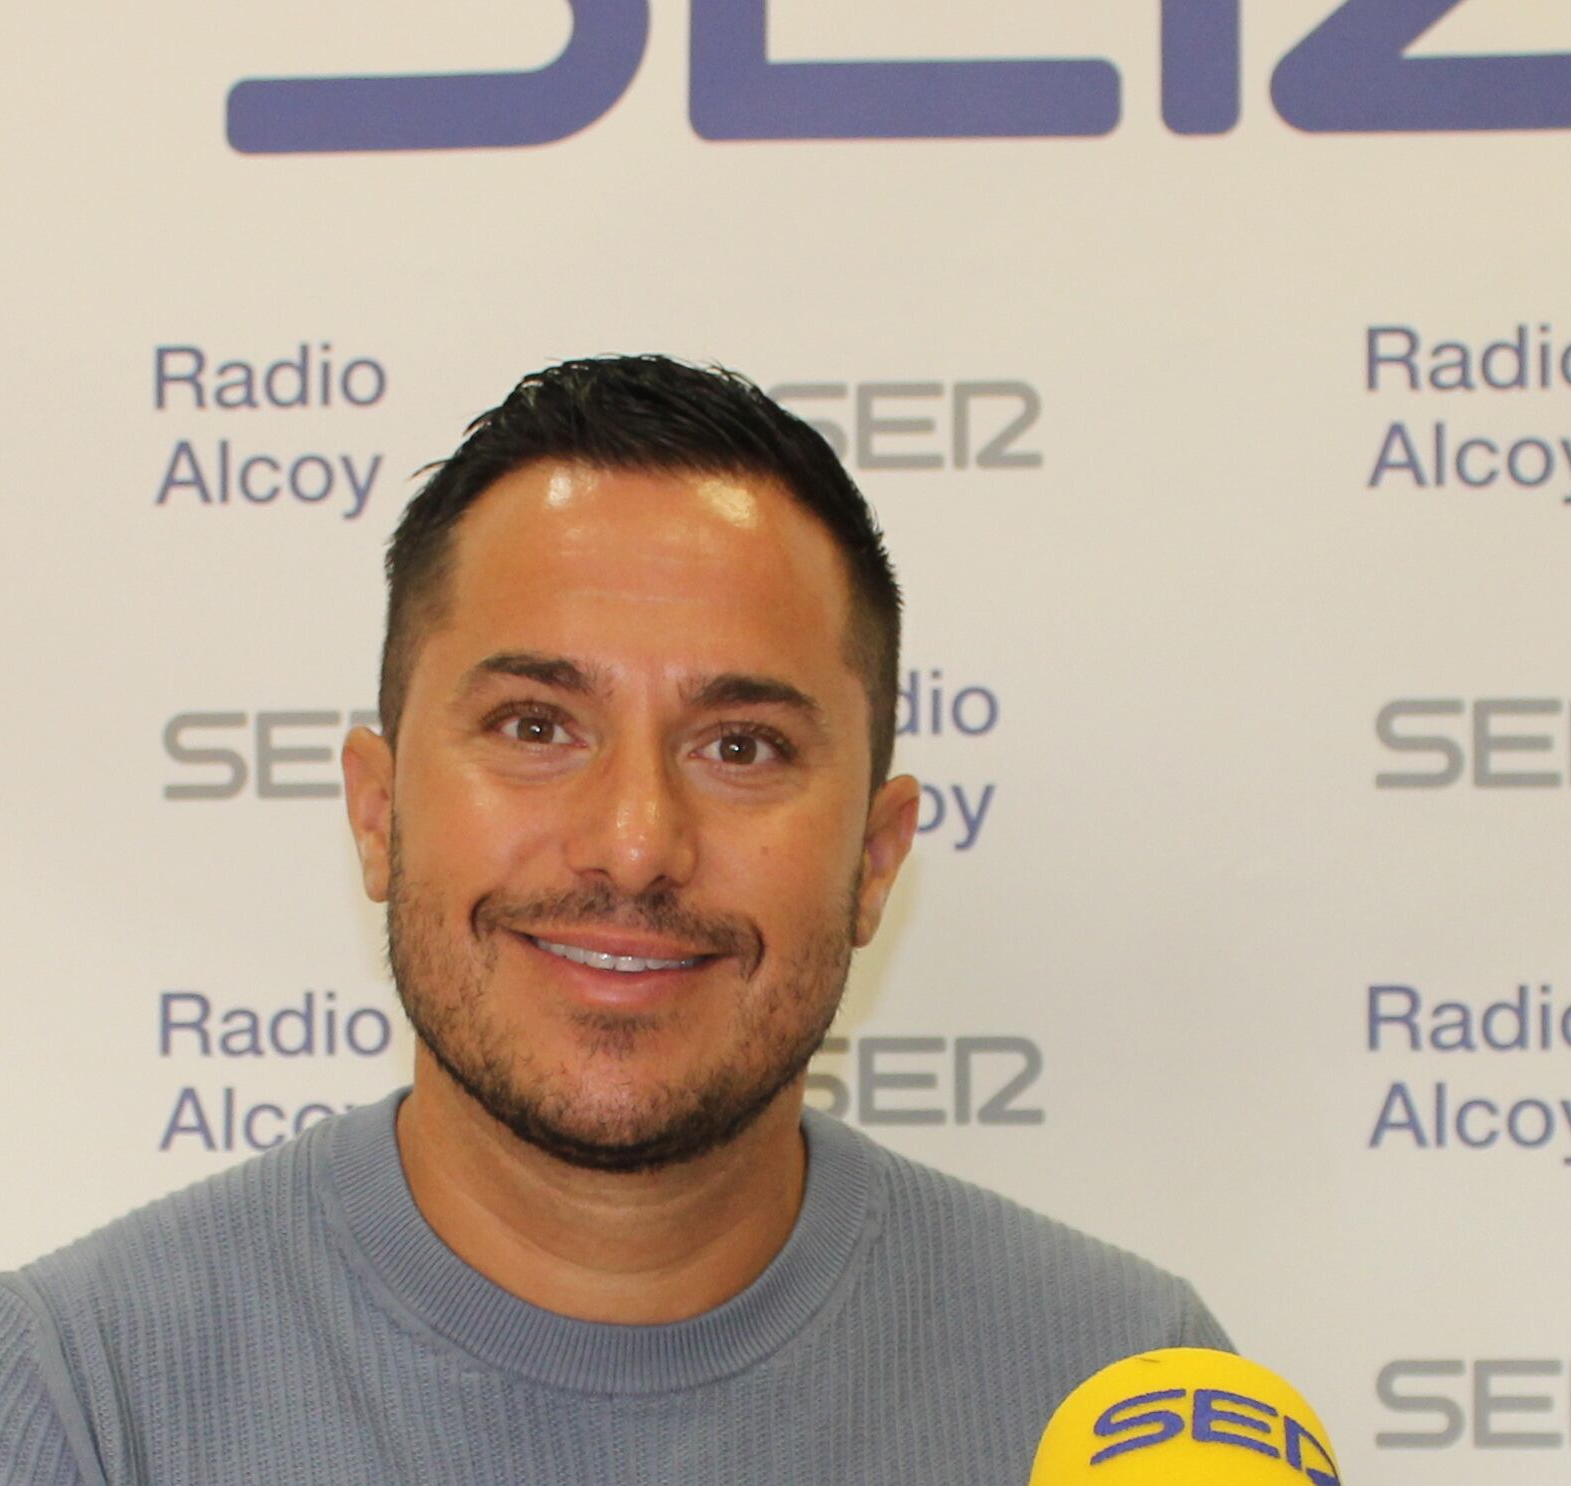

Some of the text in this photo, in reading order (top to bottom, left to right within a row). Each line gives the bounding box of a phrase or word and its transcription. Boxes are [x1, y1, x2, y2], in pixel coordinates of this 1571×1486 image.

[154, 343, 387, 410] Radio
[156, 439, 383, 520] Alcoy
[895, 669, 1000, 736] dio
[162, 710, 380, 800] SE
[158, 990, 392, 1058] Radio
[159, 1086, 362, 1152] Alc
